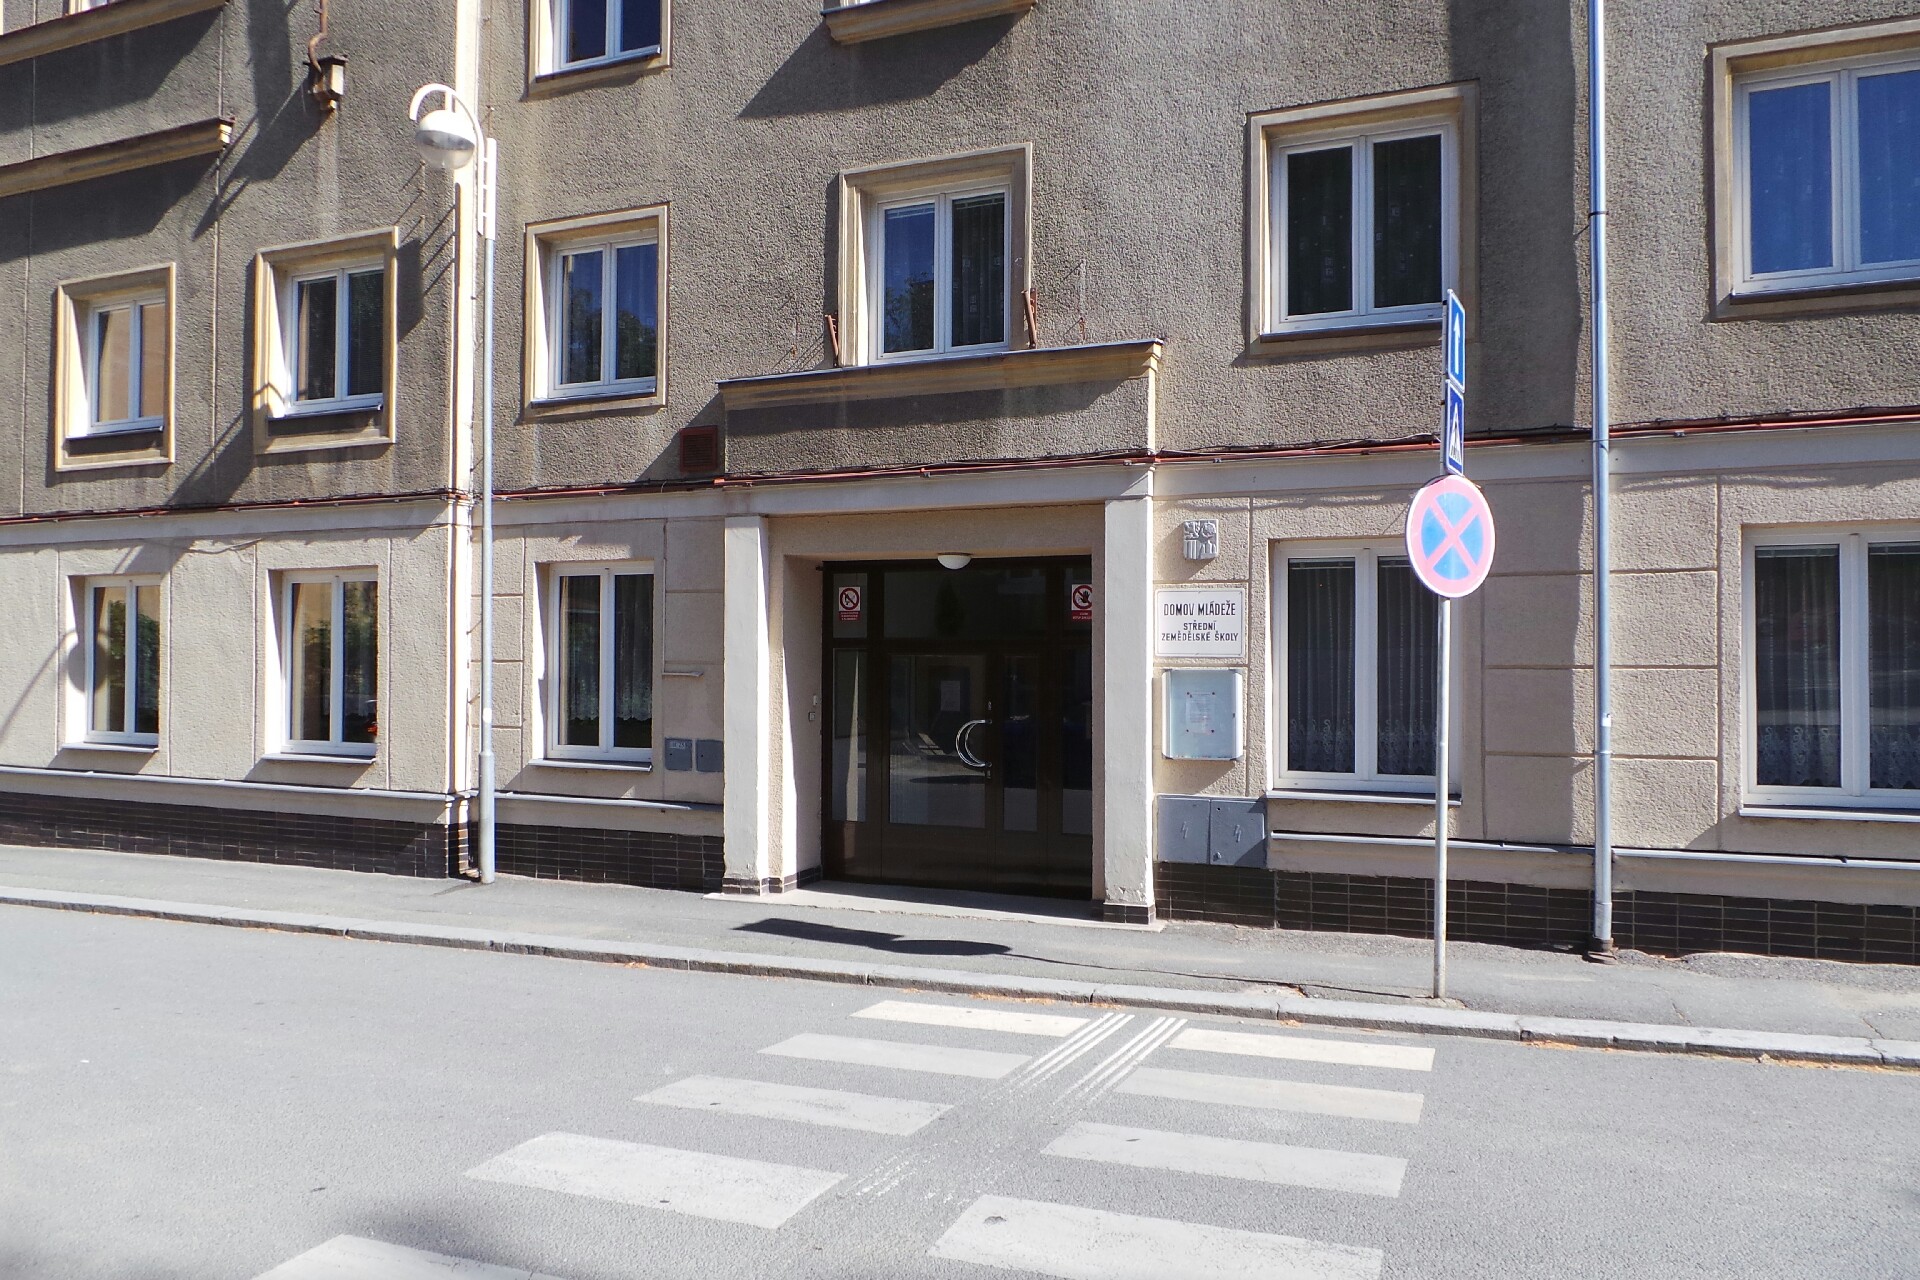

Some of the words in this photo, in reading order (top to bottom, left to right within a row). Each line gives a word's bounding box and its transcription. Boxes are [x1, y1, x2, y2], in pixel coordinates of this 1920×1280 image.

[1163, 603, 1194, 616] DOMOV
[1198, 600, 1236, 616] MLÁDEŽE
[1183, 620, 1217, 630] STŘEDNÍ
[1161, 631, 1211, 641] ZEMĚDĚLSKÉ
[1214, 630, 1239, 641] ŠKOLY
